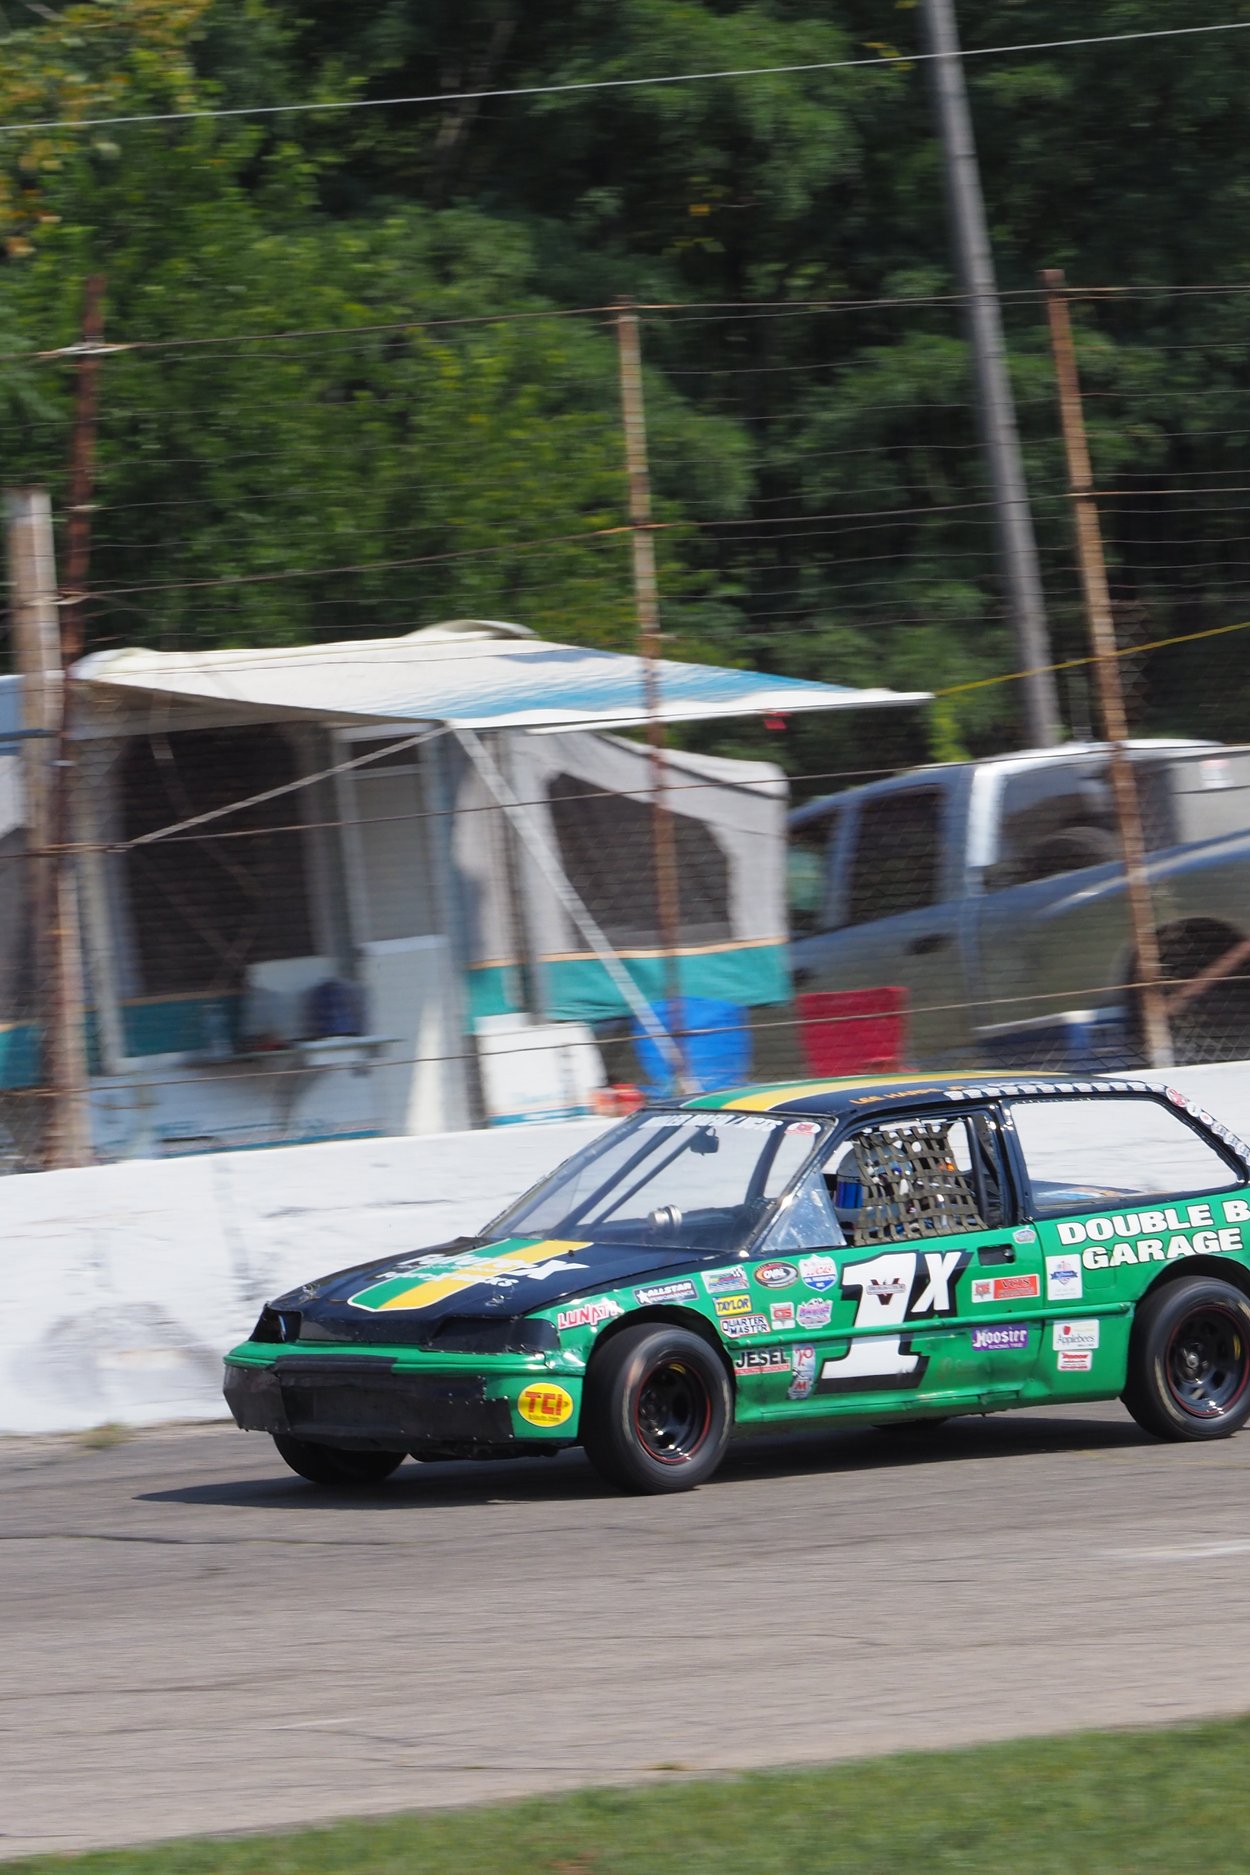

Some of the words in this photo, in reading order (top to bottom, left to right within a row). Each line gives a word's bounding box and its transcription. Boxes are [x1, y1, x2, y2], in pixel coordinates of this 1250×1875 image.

[1056, 1204, 1214, 1246] DOUBLE
[1081, 1227, 1244, 1270] GARAGE
[647, 1283, 693, 1297] ALLSTAR
[717, 1298, 749, 1312] TAYLOR
[722, 1315, 765, 1332] QUARTER
[819, 1251, 966, 1384] 1X
[731, 1323, 768, 1335] MASTER
[972, 1326, 1027, 1348] Hoosier
[736, 1348, 790, 1368] JESEL
[525, 1391, 562, 1416] TCI
